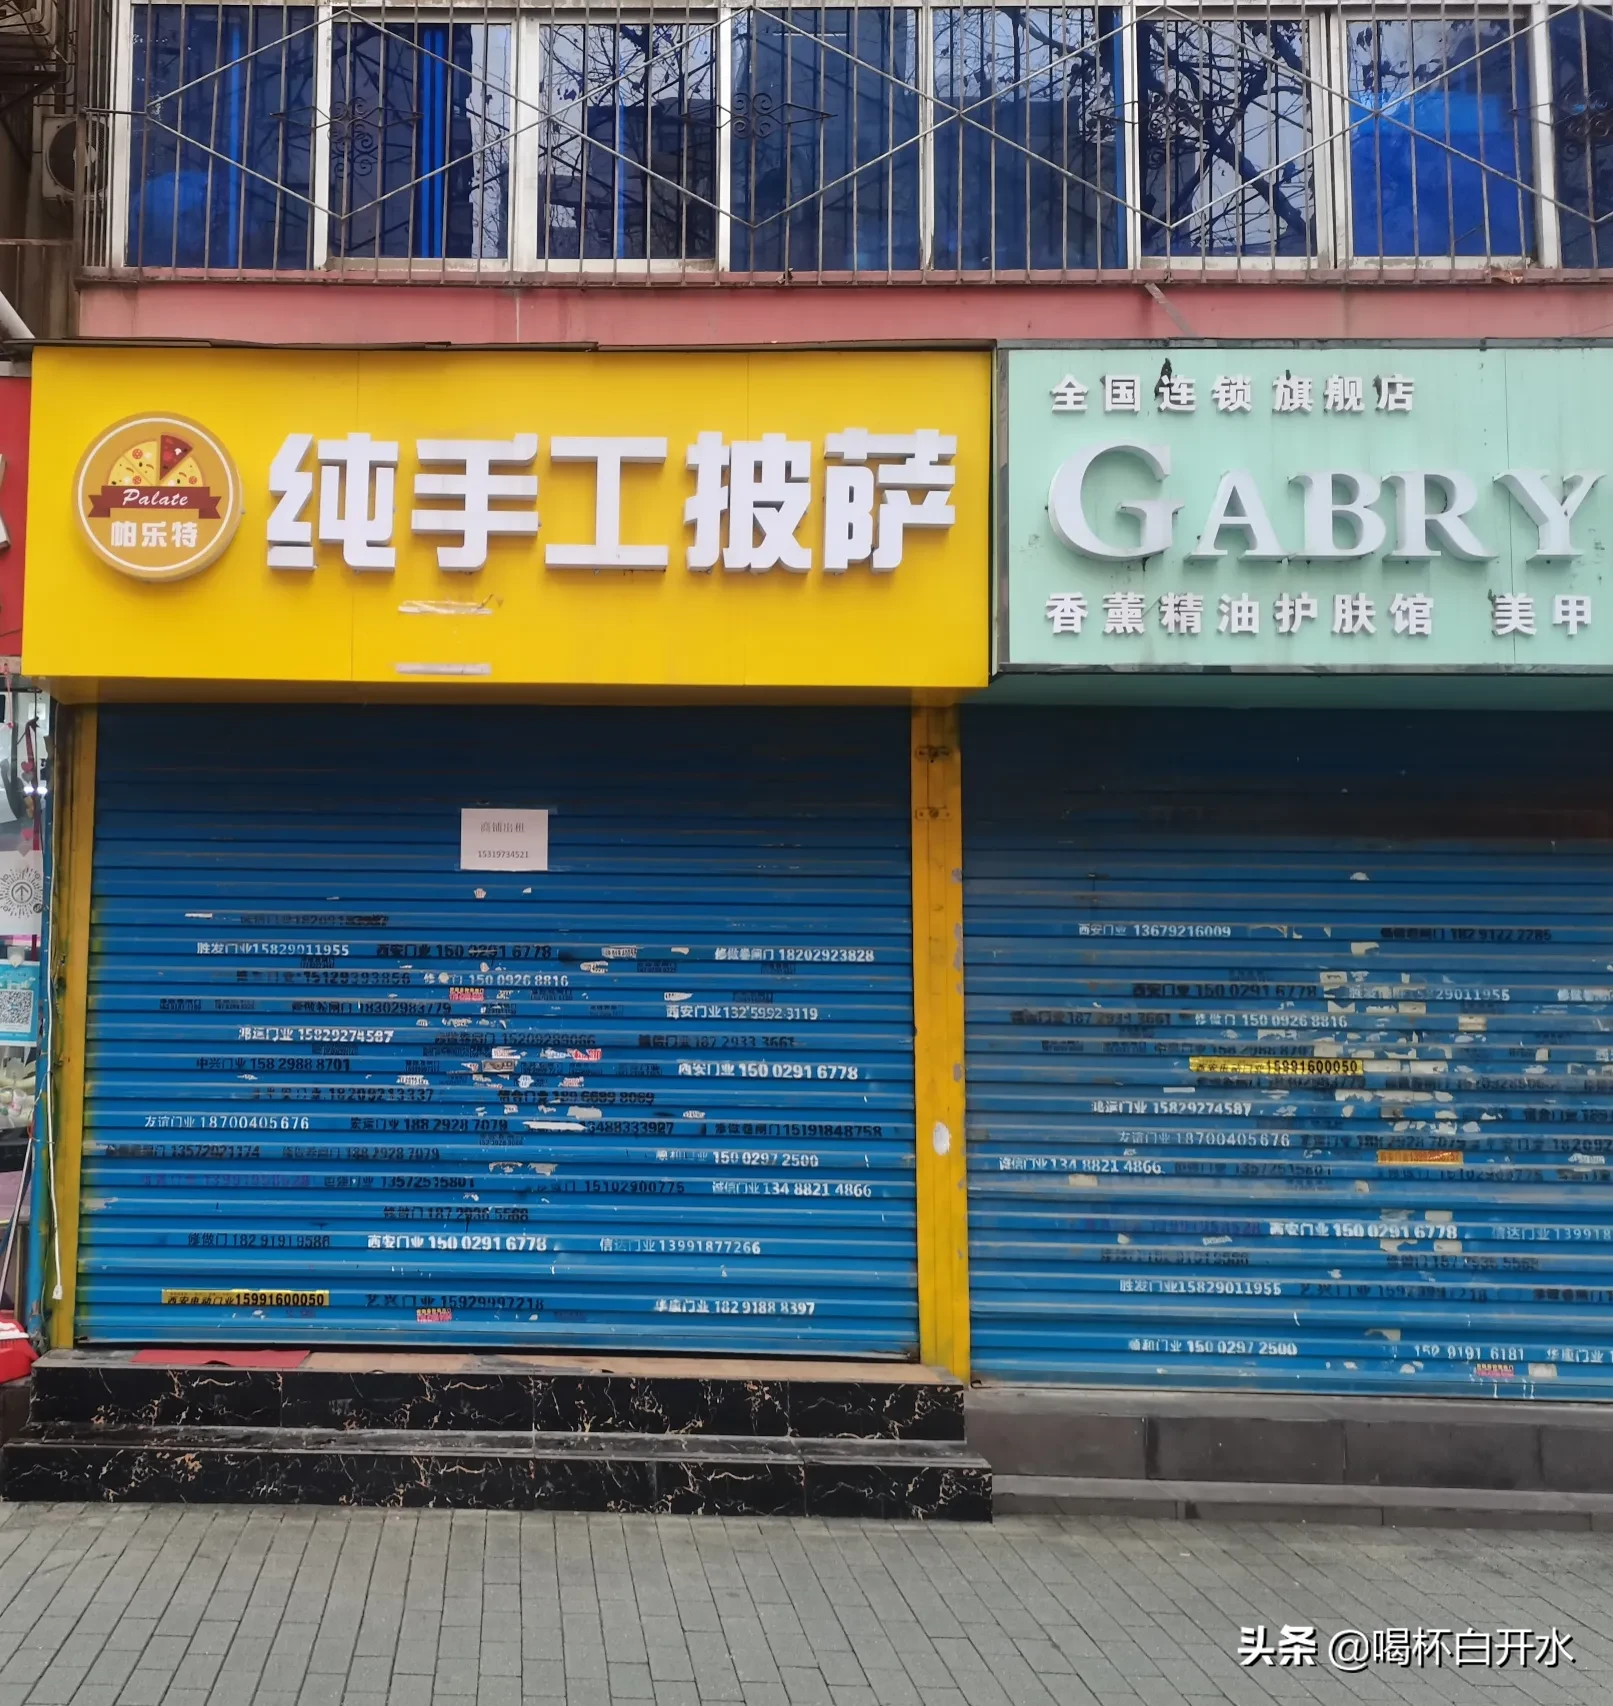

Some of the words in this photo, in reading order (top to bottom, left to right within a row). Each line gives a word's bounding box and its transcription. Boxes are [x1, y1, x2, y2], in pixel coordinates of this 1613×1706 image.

[1050, 373, 1416, 414] 全国连锁旗舰店
[121, 486, 189, 508] Palate
[267, 428, 957, 574] 纯手工披萨
[1048, 438, 1606, 564] GABRY
[110, 520, 199, 549] 帕乐特
[1046, 591, 1435, 636] 香薰精油护肤馆
[1493, 594, 1593, 637] 美甲
